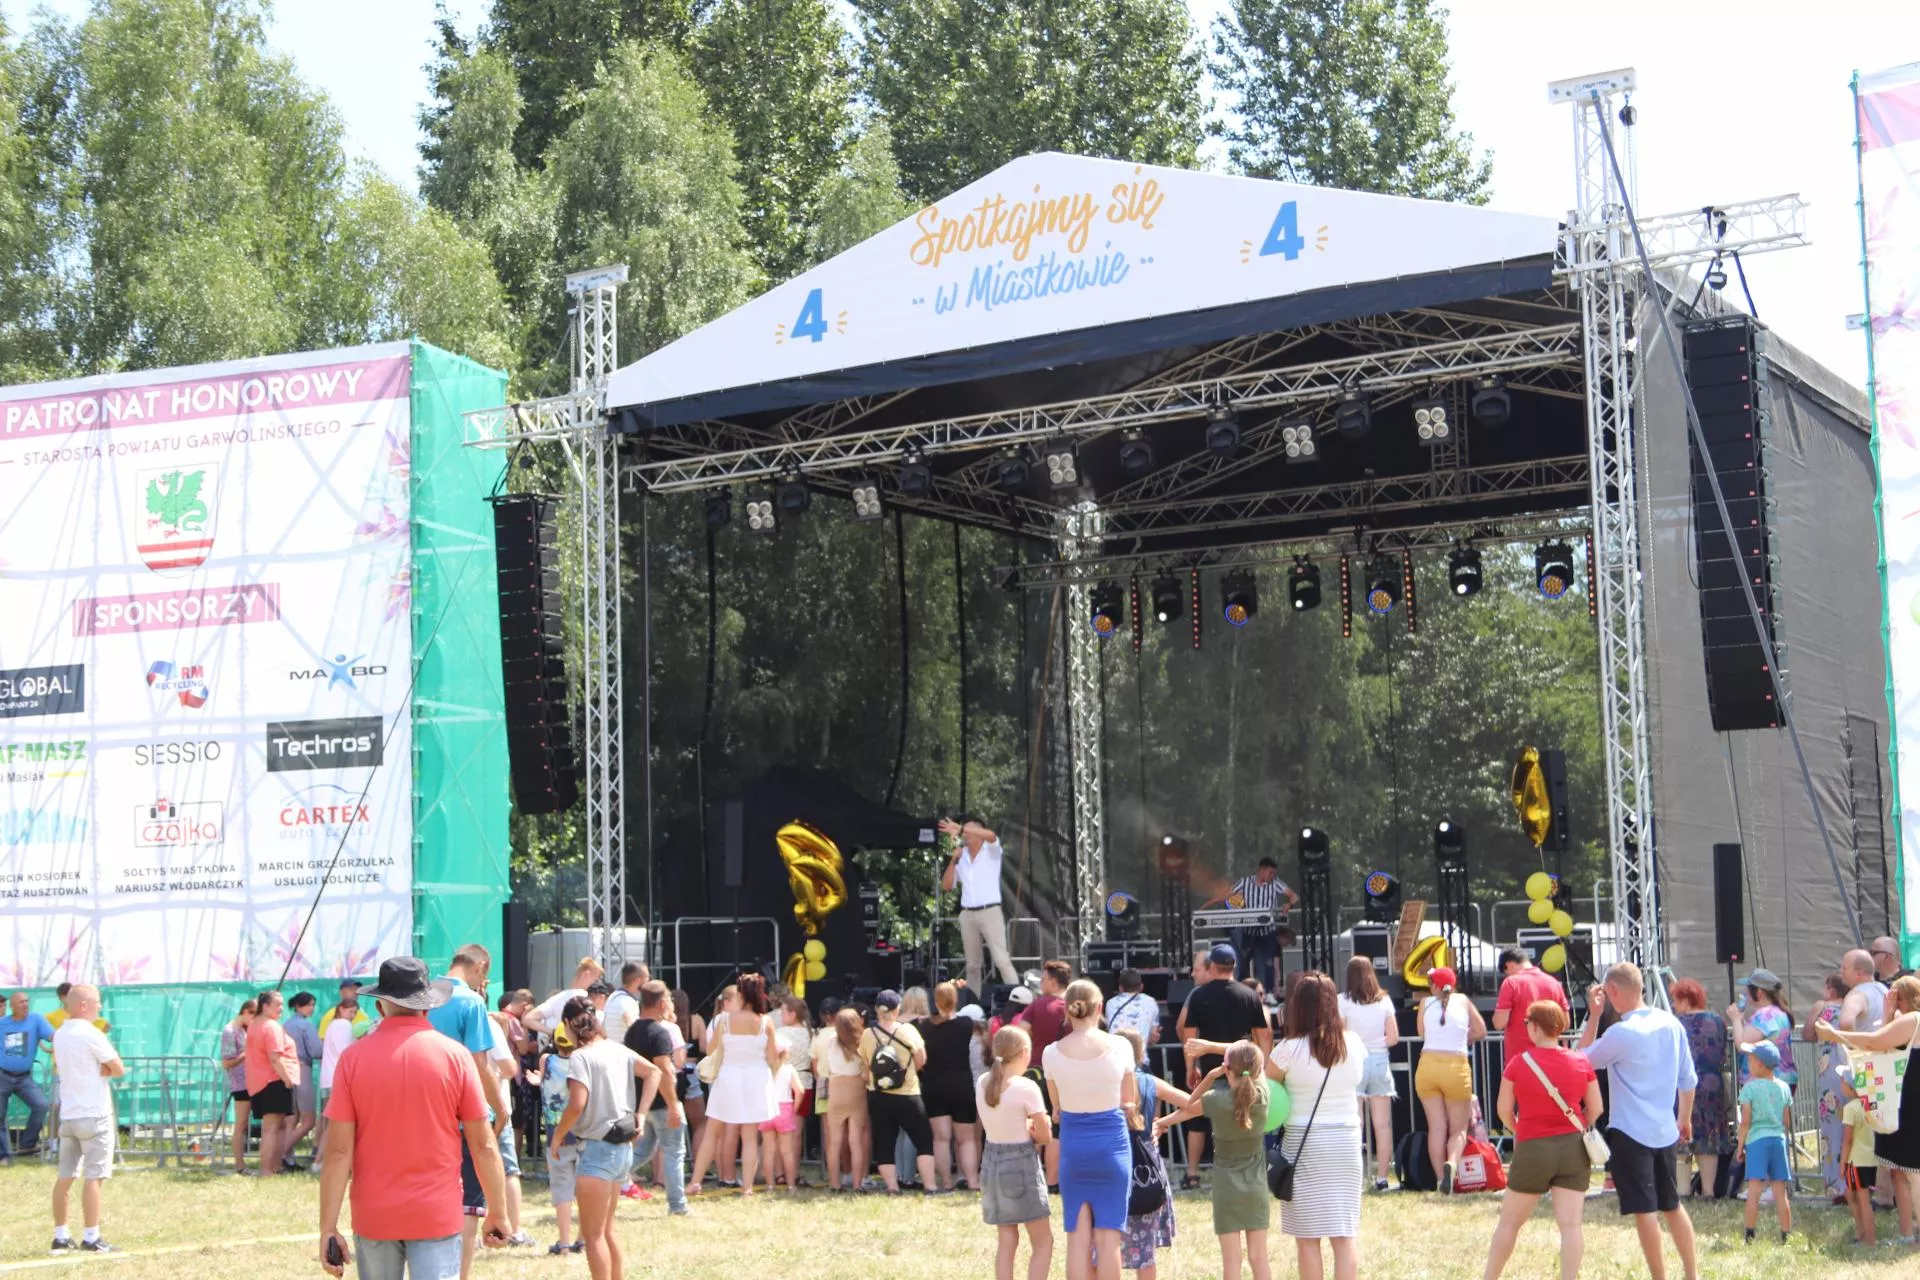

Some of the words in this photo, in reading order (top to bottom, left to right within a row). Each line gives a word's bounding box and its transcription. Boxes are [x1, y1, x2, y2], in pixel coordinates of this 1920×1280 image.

[910, 183, 1099, 268] Spotkajmy
[1106, 166, 1165, 230] się
[1259, 200, 1305, 261] 4
[935, 282, 958, 314] w
[966, 240, 1130, 311] Miastkowie
[790, 288, 828, 343] 4
[5, 391, 161, 433] PATRONAT
[171, 368, 365, 416] HONOROWY
[24, 445, 102, 466] STAROSTA
[108, 436, 181, 457] POWIATU
[187, 420, 341, 448] GARWOLIŃSKIEGO
[94, 590, 259, 628] SPONSORZY
[155, 680, 203, 690] RECYCLING
[181, 665, 204, 680] RM
[0, 674, 72, 699] GLOBAL
[280, 804, 370, 826] CARTEX
[142, 816, 218, 848] czajka
[27, 871, 81, 882] KOSIOREK
[123, 867, 166, 877] SOŁTYS
[170, 864, 236, 876] MIASTKOWA
[258, 860, 304, 871] MARCIN
[114, 882, 166, 893] MARIUSZ
[169, 880, 244, 891] WŁODARCZYK
[274, 876, 318, 886] USŁUGI
